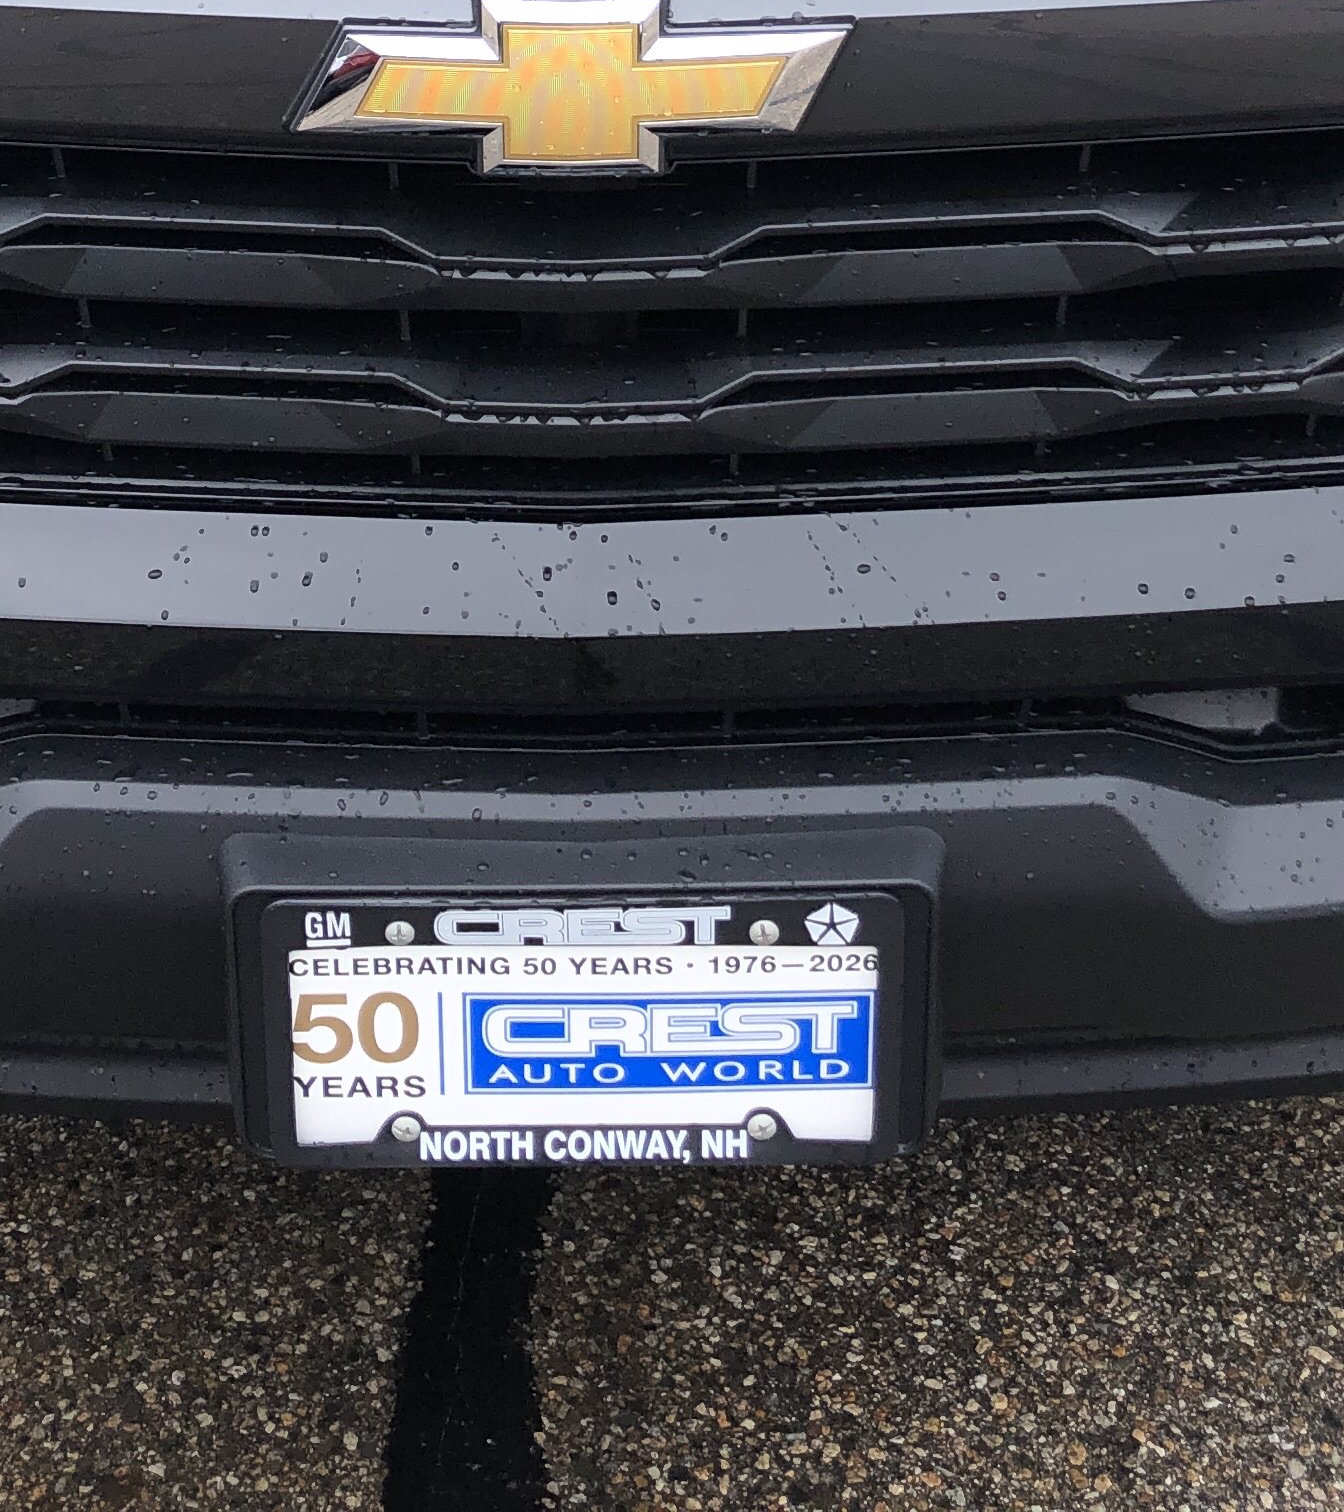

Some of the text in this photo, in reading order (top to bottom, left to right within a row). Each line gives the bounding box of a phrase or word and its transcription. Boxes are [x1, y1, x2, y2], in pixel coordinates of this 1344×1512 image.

[304, 910, 351, 938] GM
[433, 904, 732, 946] CREST
[289, 955, 510, 977] CELEBRATING
[522, 957, 558, 976] 50
[568, 955, 674, 976] YEARS
[292, 990, 420, 1064] 50
[481, 1000, 858, 1059] CREST
[293, 1075, 427, 1099] YEARS
[488, 1058, 851, 1085] AUTO WORLD
[418, 1127, 749, 1165] NORTH CONWAY, NH
